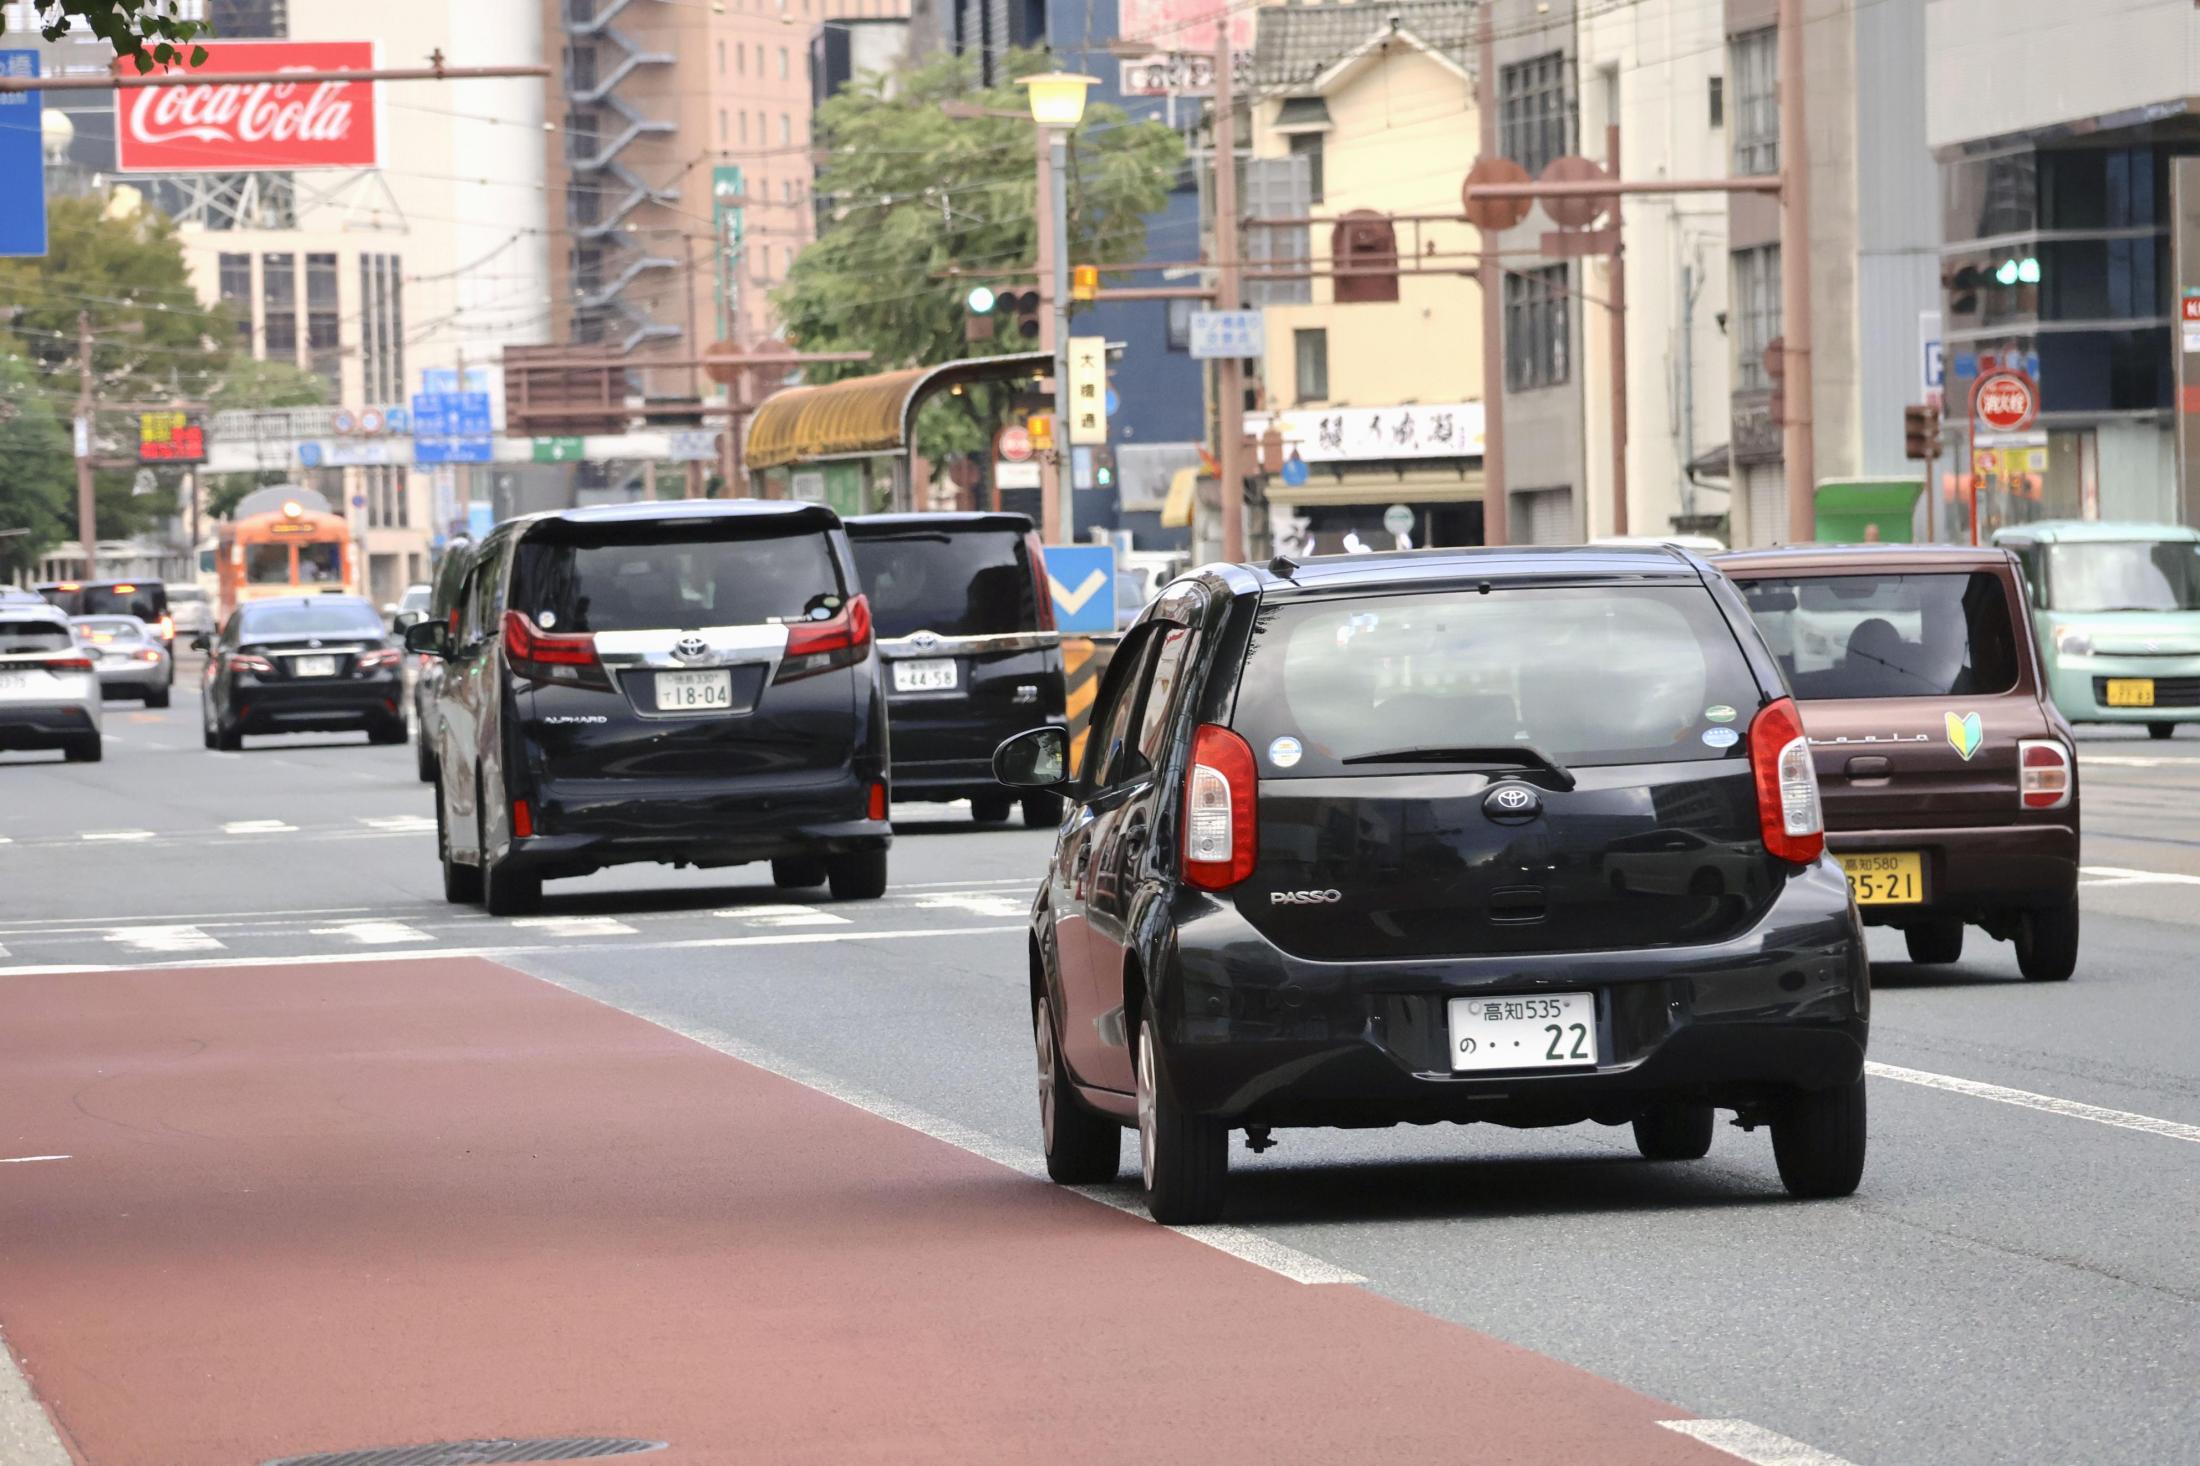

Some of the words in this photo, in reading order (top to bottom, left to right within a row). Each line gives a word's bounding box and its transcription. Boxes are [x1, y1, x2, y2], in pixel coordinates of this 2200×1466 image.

[130, 66, 352, 143] Coca-Cola
[1983, 395, 2024, 414] 消火栓
[677, 686, 727, 705] 18-04
[544, 715, 608, 725] ALPHARD
[1270, 888, 1342, 905] PASSO
[1483, 999, 1562, 1021] 高知535
